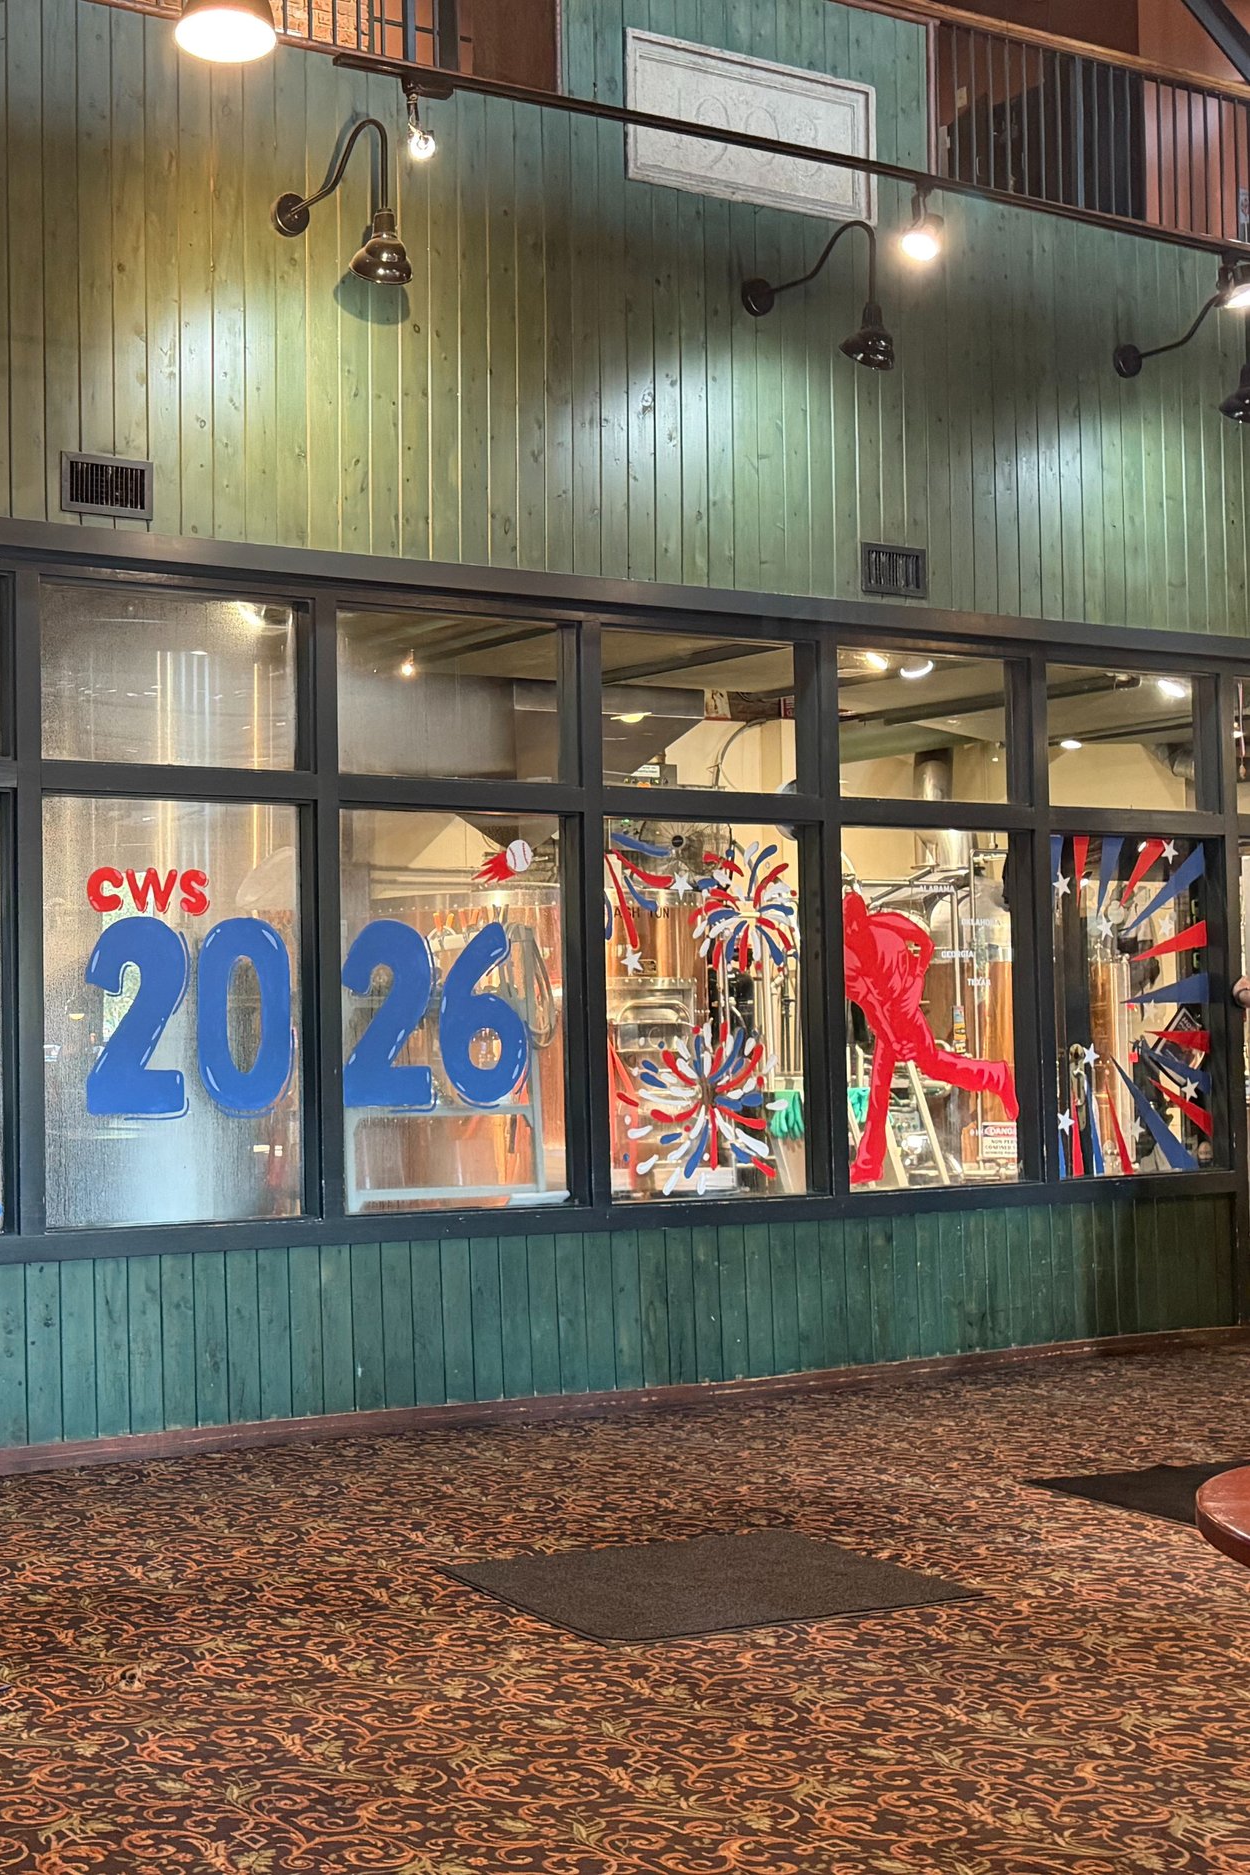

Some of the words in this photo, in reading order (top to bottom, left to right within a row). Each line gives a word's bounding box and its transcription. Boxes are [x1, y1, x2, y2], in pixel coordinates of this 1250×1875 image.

[86, 865, 211, 916] CWS
[919, 885, 956, 893] ALABAMA
[941, 950, 975, 959] GEORGIA
